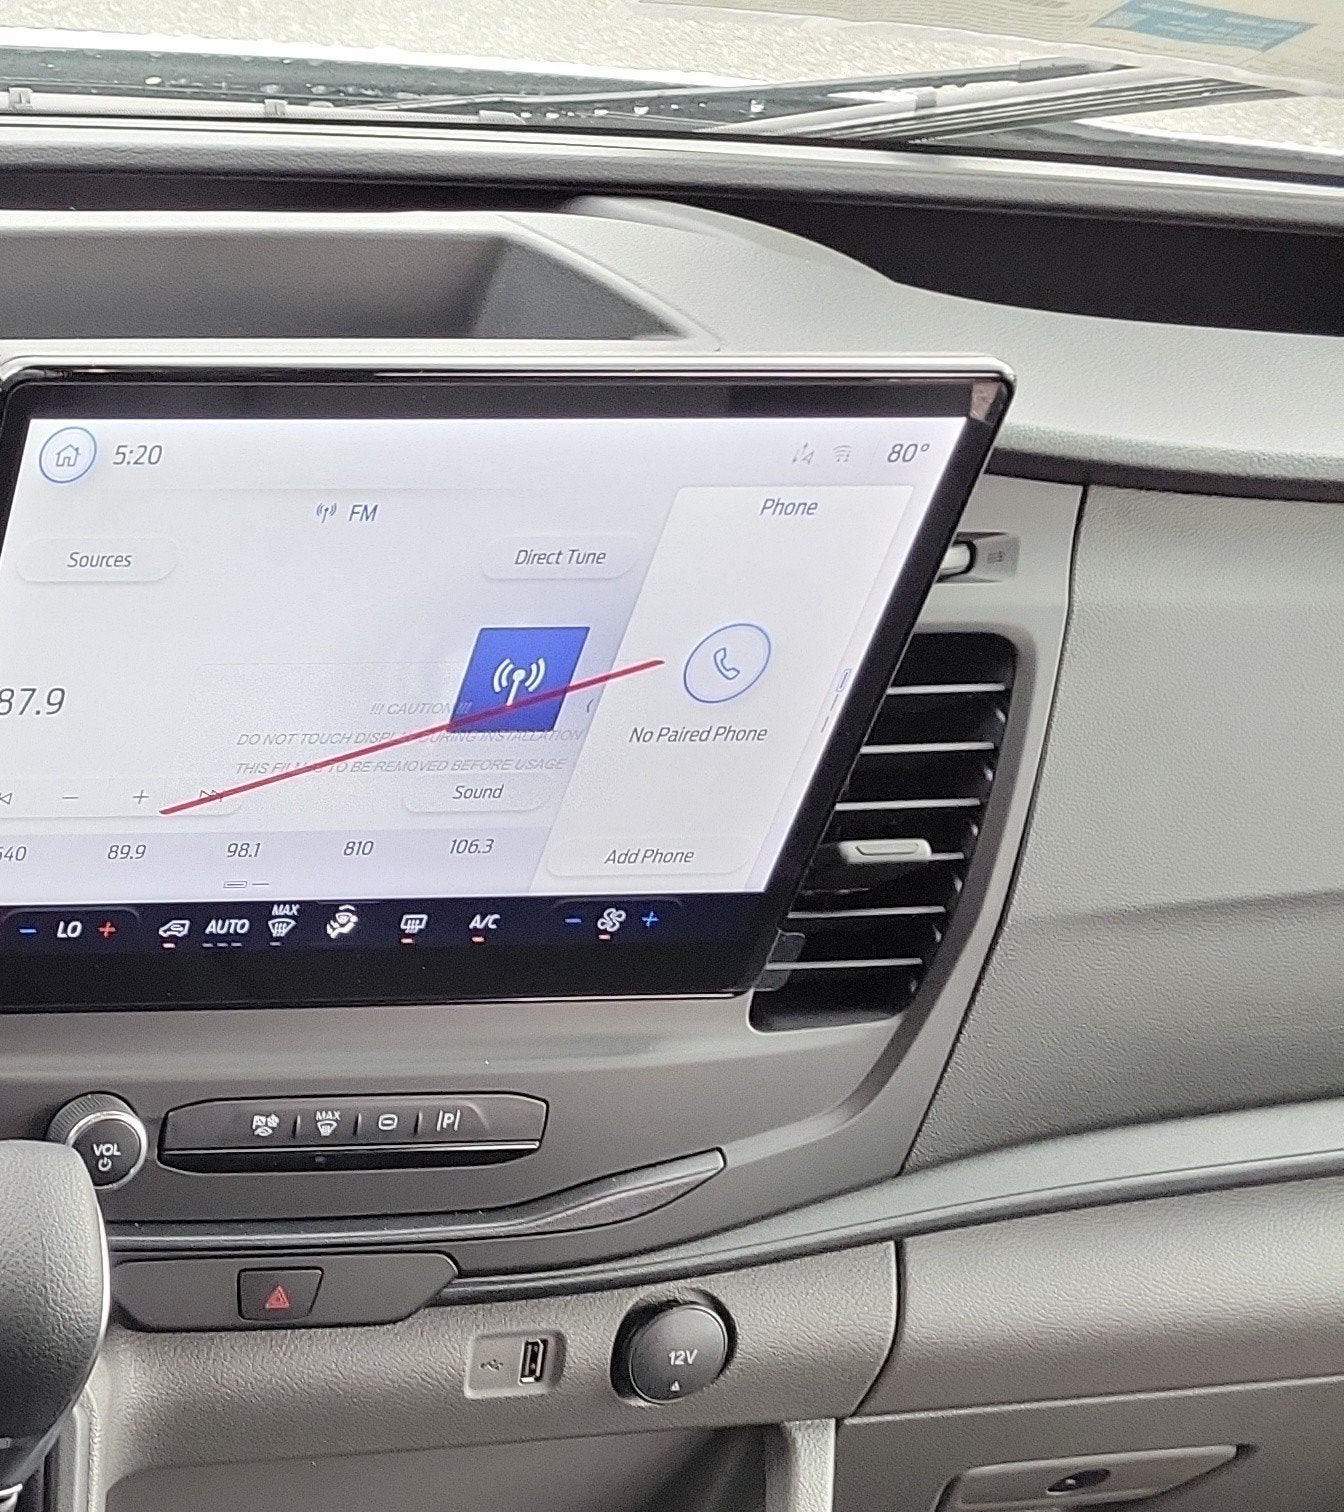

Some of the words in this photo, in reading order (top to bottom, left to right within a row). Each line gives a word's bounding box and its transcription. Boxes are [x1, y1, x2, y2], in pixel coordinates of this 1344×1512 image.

[113, 444, 163, 467] 5:20
[348, 503, 379, 523] FM
[759, 496, 819, 518] Phone
[67, 550, 133, 569] Sources
[514, 547, 564, 567] Direct
[566, 547, 607, 566] Tune
[387, 702, 452, 715] CAUTION
[236, 733, 261, 746] DO
[262, 733, 298, 746] NOT
[300, 732, 352, 745] TOUCH
[628, 727, 656, 743] No
[656, 727, 711, 743] Paired
[712, 726, 768, 742] Phone
[235, 762, 271, 775] THIS
[350, 760, 373, 773] BE
[373, 759, 449, 773] REMOVED
[450, 759, 513, 772] BEFORE
[513, 758, 568, 771] USAGE
[452, 783, 504, 800] Sound
[106, 843, 148, 861] 89.9
[226, 842, 262, 859] 98.1
[343, 840, 375, 857] 810
[449, 838, 495, 855] 106.3
[604, 849, 639, 865] Add
[640, 848, 696, 865] Phone
[272, 904, 300, 917] MAX
[56, 920, 83, 939] LO
[205, 917, 250, 935] AUTO
[469, 913, 501, 930] A/C
[316, 1110, 341, 1122] MAX
[92, 1142, 122, 1158] VOL
[667, 1348, 699, 1366] 12V
